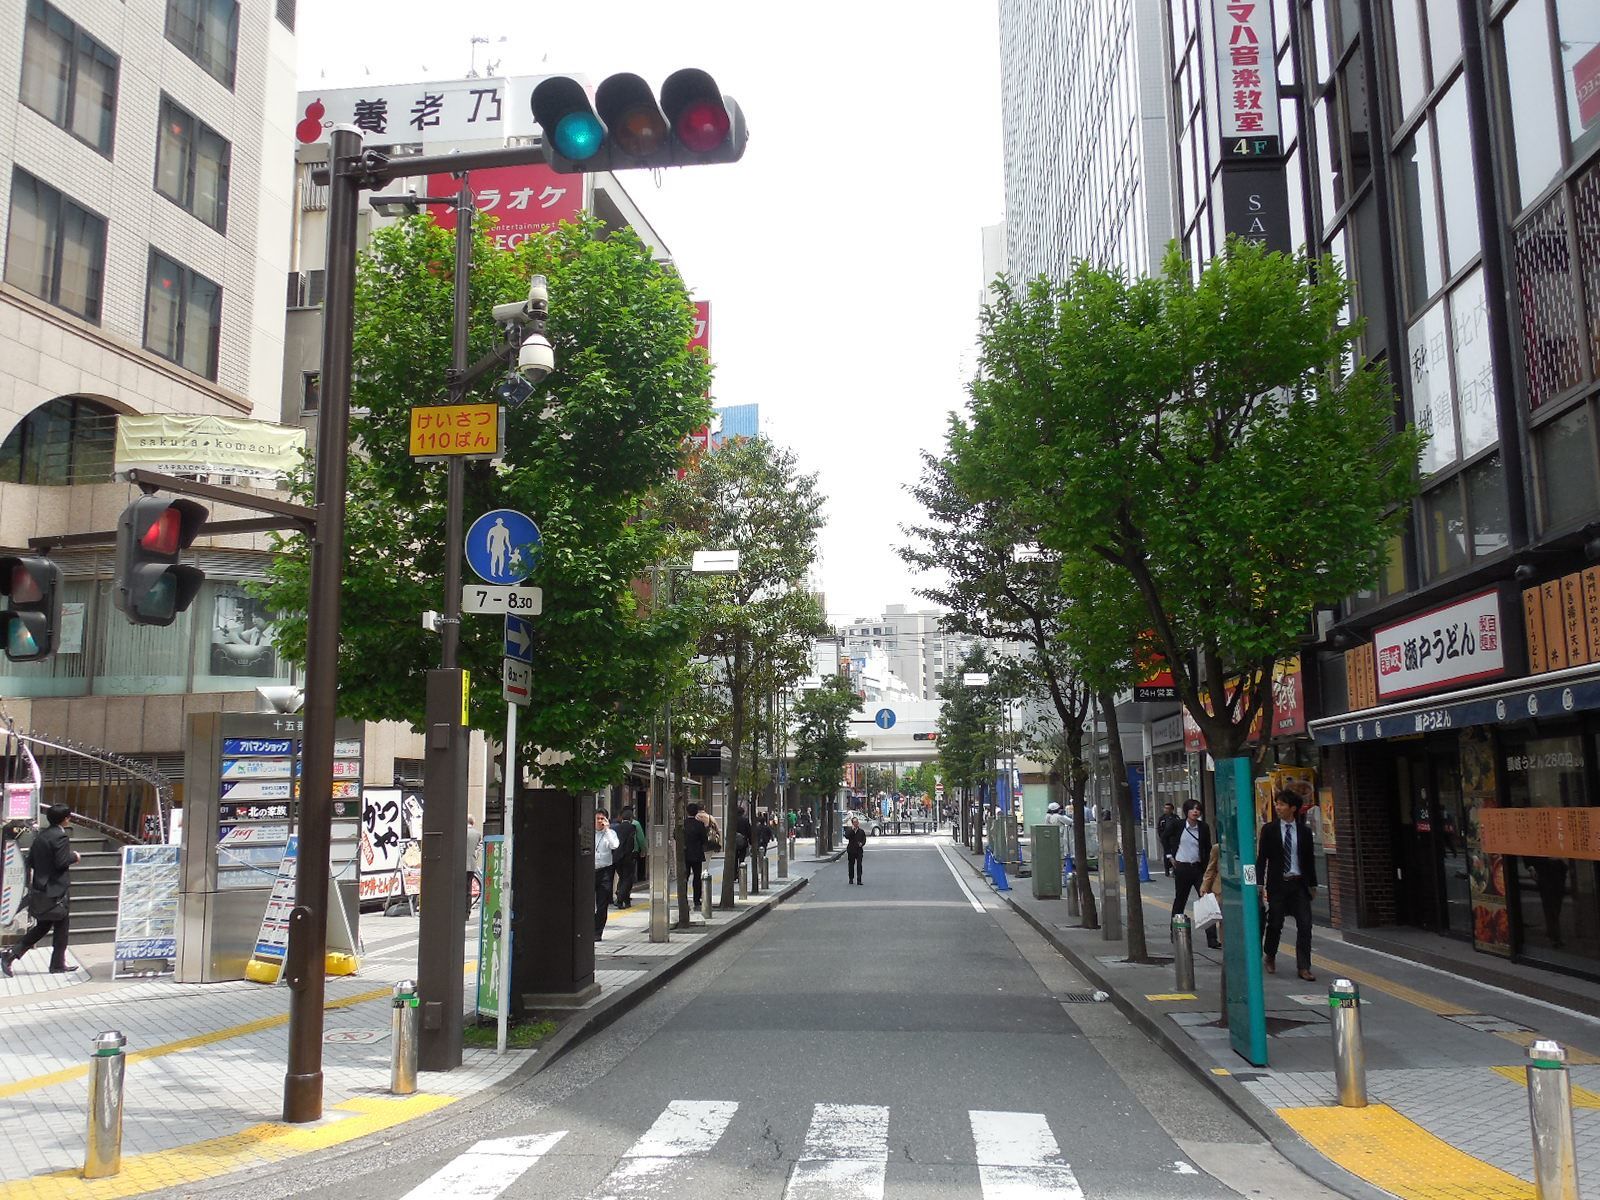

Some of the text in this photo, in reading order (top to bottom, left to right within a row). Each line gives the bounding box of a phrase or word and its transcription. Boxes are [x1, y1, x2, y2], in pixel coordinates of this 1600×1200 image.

[1227, 0, 1264, 132] マハ音楽教室
[354, 88, 542, 135] 養老乃
[417, 411, 491, 430] けいさつ
[139, 437, 199, 448] sakura
[215, 438, 282, 456] komachi
[417, 431, 490, 449] 110ばん
[239, 741, 290, 752] アパマンショップ
[248, 805, 287, 817] 北の家族
[363, 797, 399, 860] かつや
